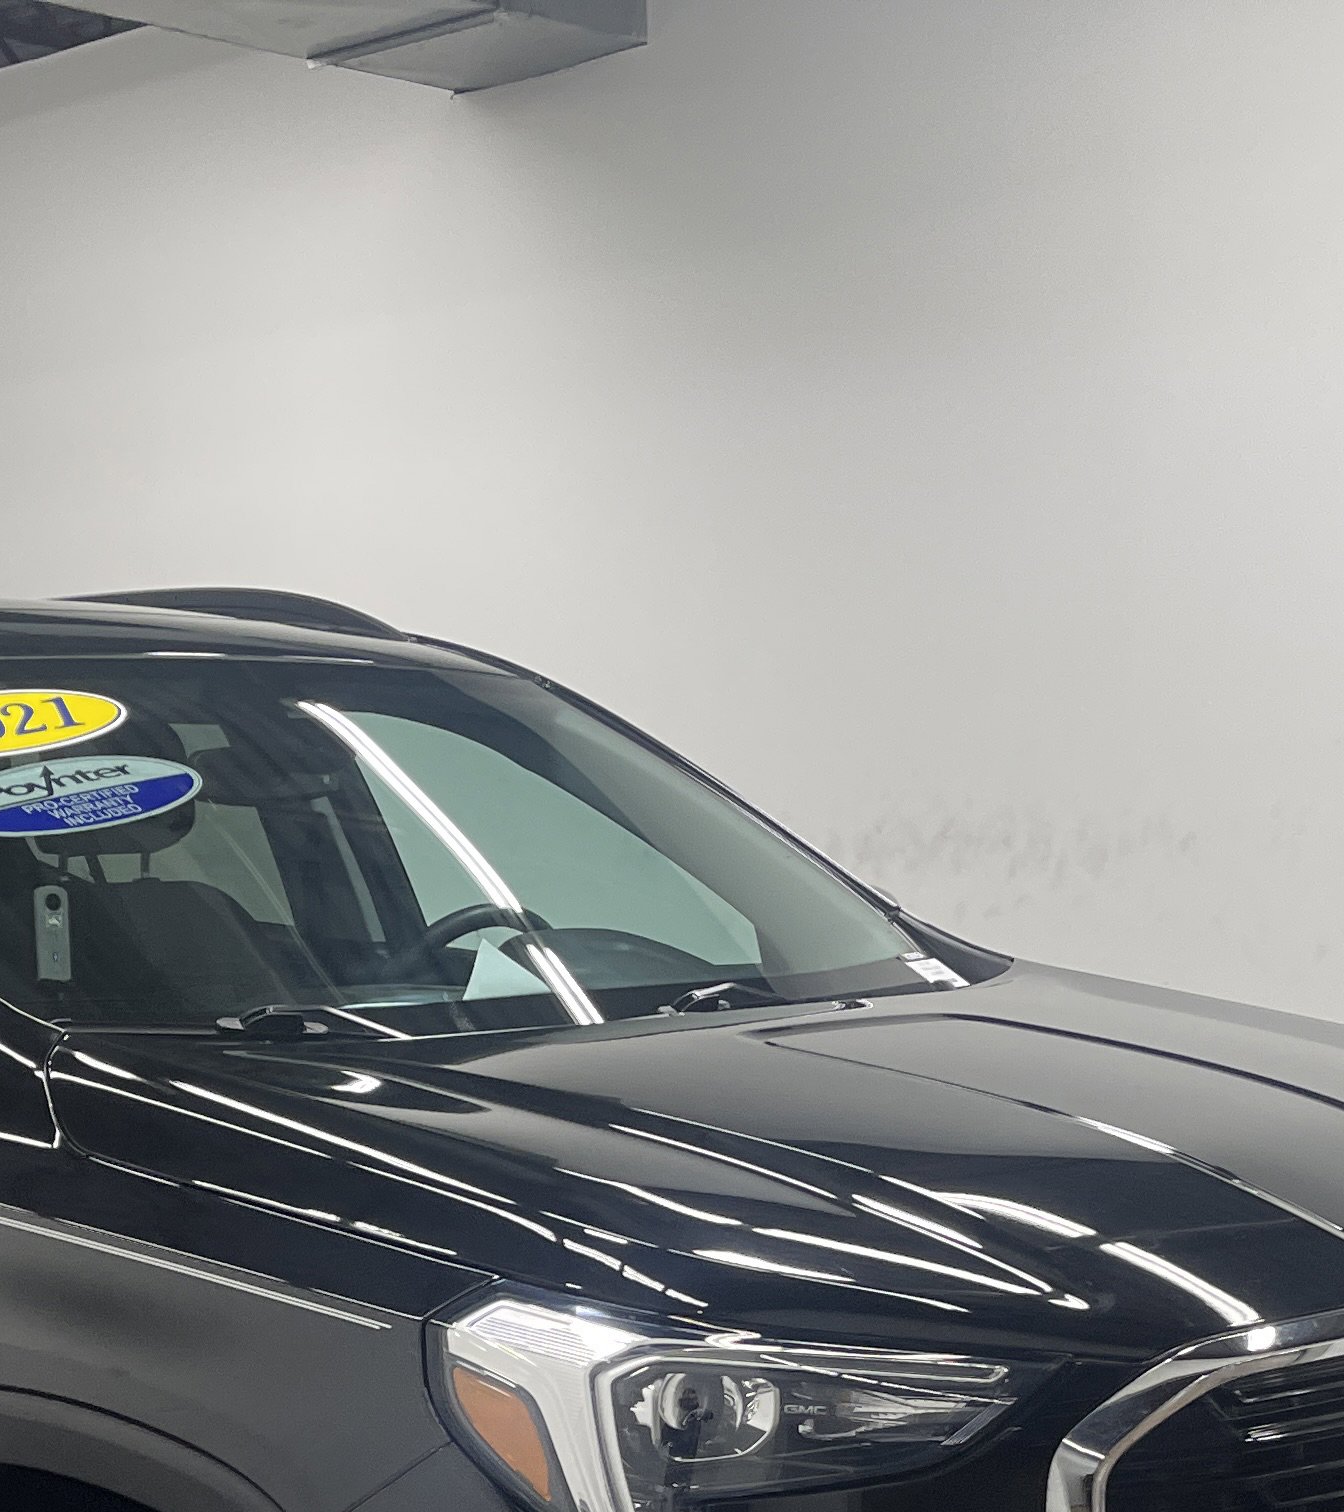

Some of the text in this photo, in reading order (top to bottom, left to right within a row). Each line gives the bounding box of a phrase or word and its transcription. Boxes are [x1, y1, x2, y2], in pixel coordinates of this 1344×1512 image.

[48, 795, 135, 819] WARRANTY
[64, 804, 142, 827] INCLUDED
[783, 1404, 827, 1416] GMC
